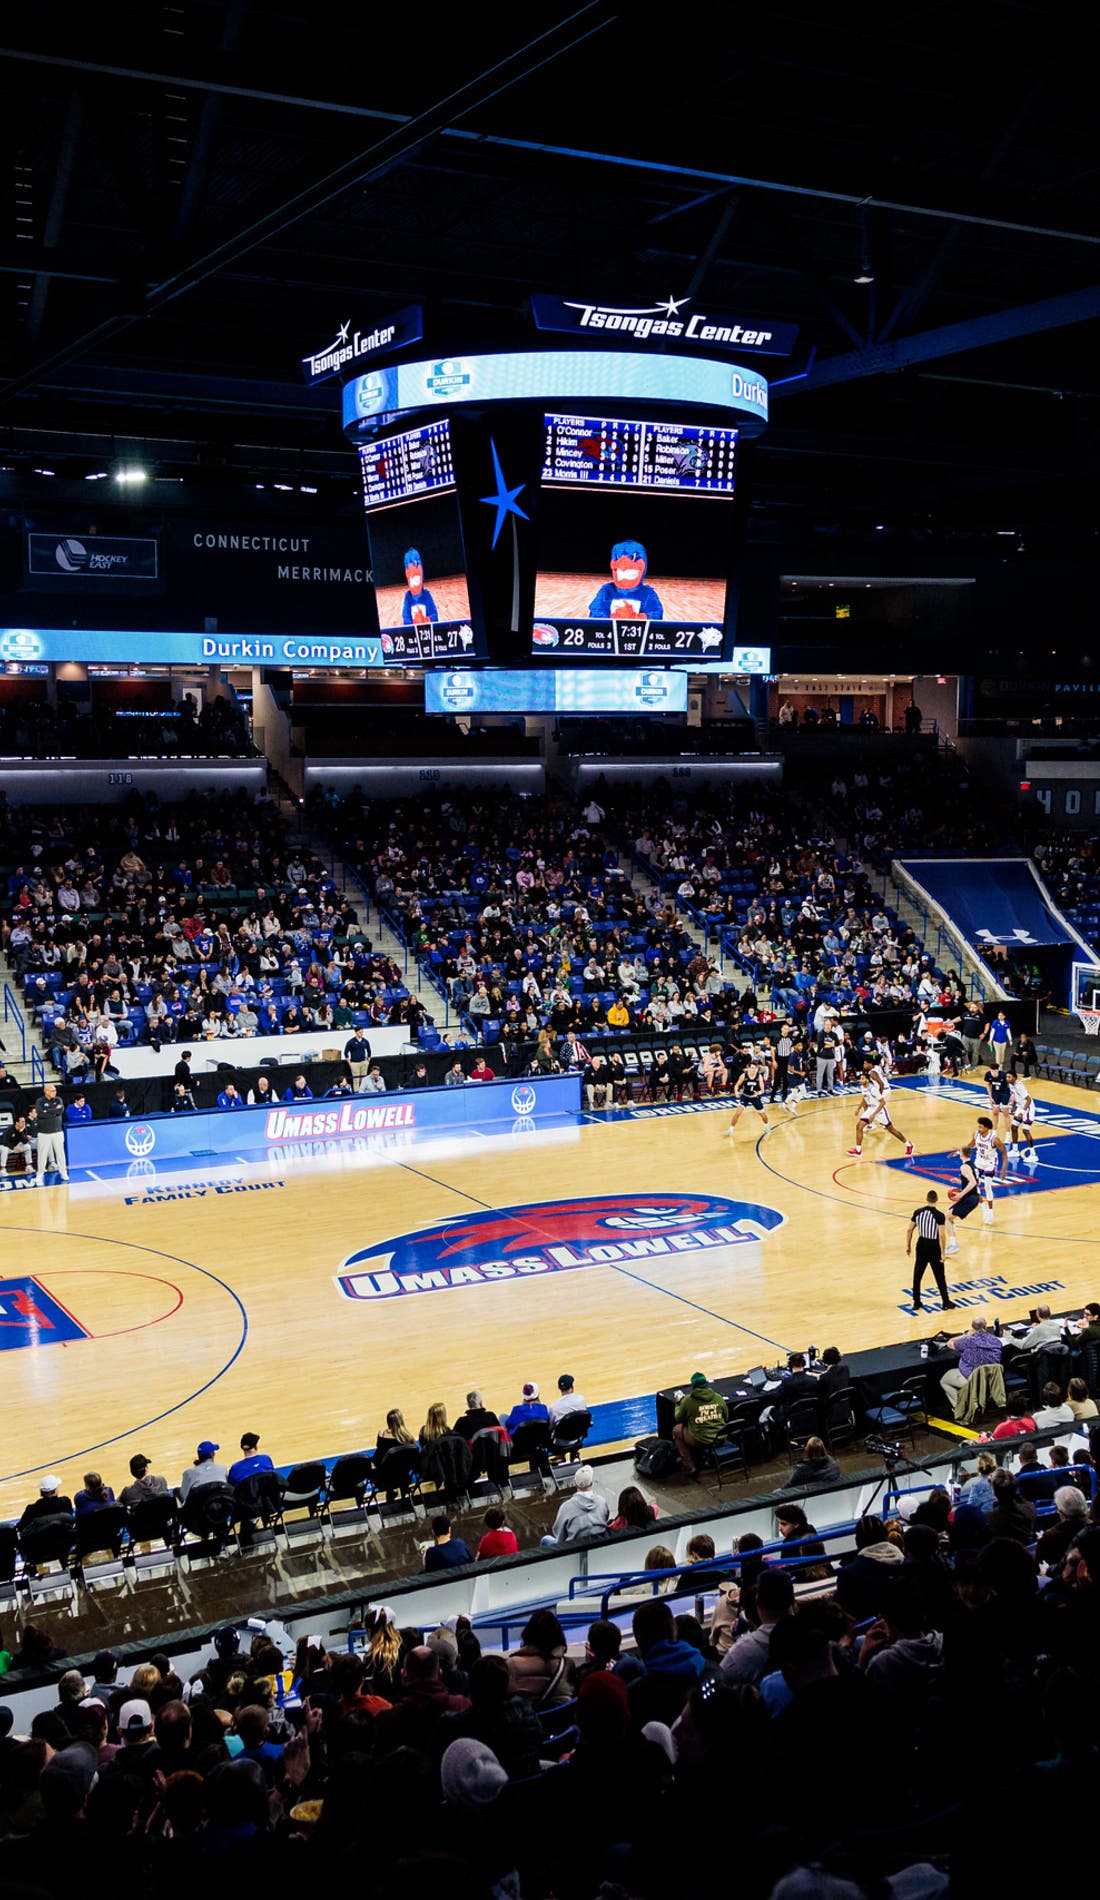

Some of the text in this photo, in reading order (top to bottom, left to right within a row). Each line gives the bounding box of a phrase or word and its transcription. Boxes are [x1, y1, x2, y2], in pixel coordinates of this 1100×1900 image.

[568, 302, 772, 346] Tsongas Center
[303, 325, 395, 376] Tsongas Center
[553, 417, 585, 427] PLAYERS
[653, 425, 683, 434] PLAYERS
[547, 425, 552, 434] 1
[556, 426, 593, 437] O'Connor
[600, 430, 607, 439] 0
[612, 431, 617, 440] 2
[634, 433, 639, 441] 0
[647, 433, 653, 442] 3
[656, 433, 679, 443] Baker
[546, 436, 552, 445] 2
[624, 443, 628, 451] 1
[634, 443, 638, 452] 1
[644, 443, 650, 452] 4
[655, 444, 689, 455] Robinson
[546, 447, 552, 456] 3
[622, 453, 627, 462] 0
[633, 454, 638, 462] 0
[644, 454, 649, 463] 5
[655, 454, 675, 464] Miller
[542, 468, 552, 477] 23
[554, 468, 577, 478] Morris
[545, 457, 551, 466] 4
[555, 457, 593, 469] Covington
[611, 463, 615, 471] 1
[621, 464, 626, 472] 0
[632, 465, 637, 473] 0
[644, 464, 653, 473] 15
[643, 475, 652, 484] 21
[194, 534, 310, 552] CONNECTICUT
[90, 561, 112, 569] EAST
[91, 554, 128, 563] HOCKEY
[278, 566, 374, 582] MERRIMACK
[447, 631, 458, 648] 27
[563, 628, 584, 646] 28
[621, 626, 642, 638] 7:31
[675, 631, 695, 648] 27
[203, 638, 378, 663] Durkin Company
[394, 636, 405, 653] 28
[624, 643, 637, 651] 1ST
[124, 1181, 286, 1206] FAMILY COURT
[146, 1177, 244, 1194] KENNEDY
[990, 1279, 1067, 1300] COURT
